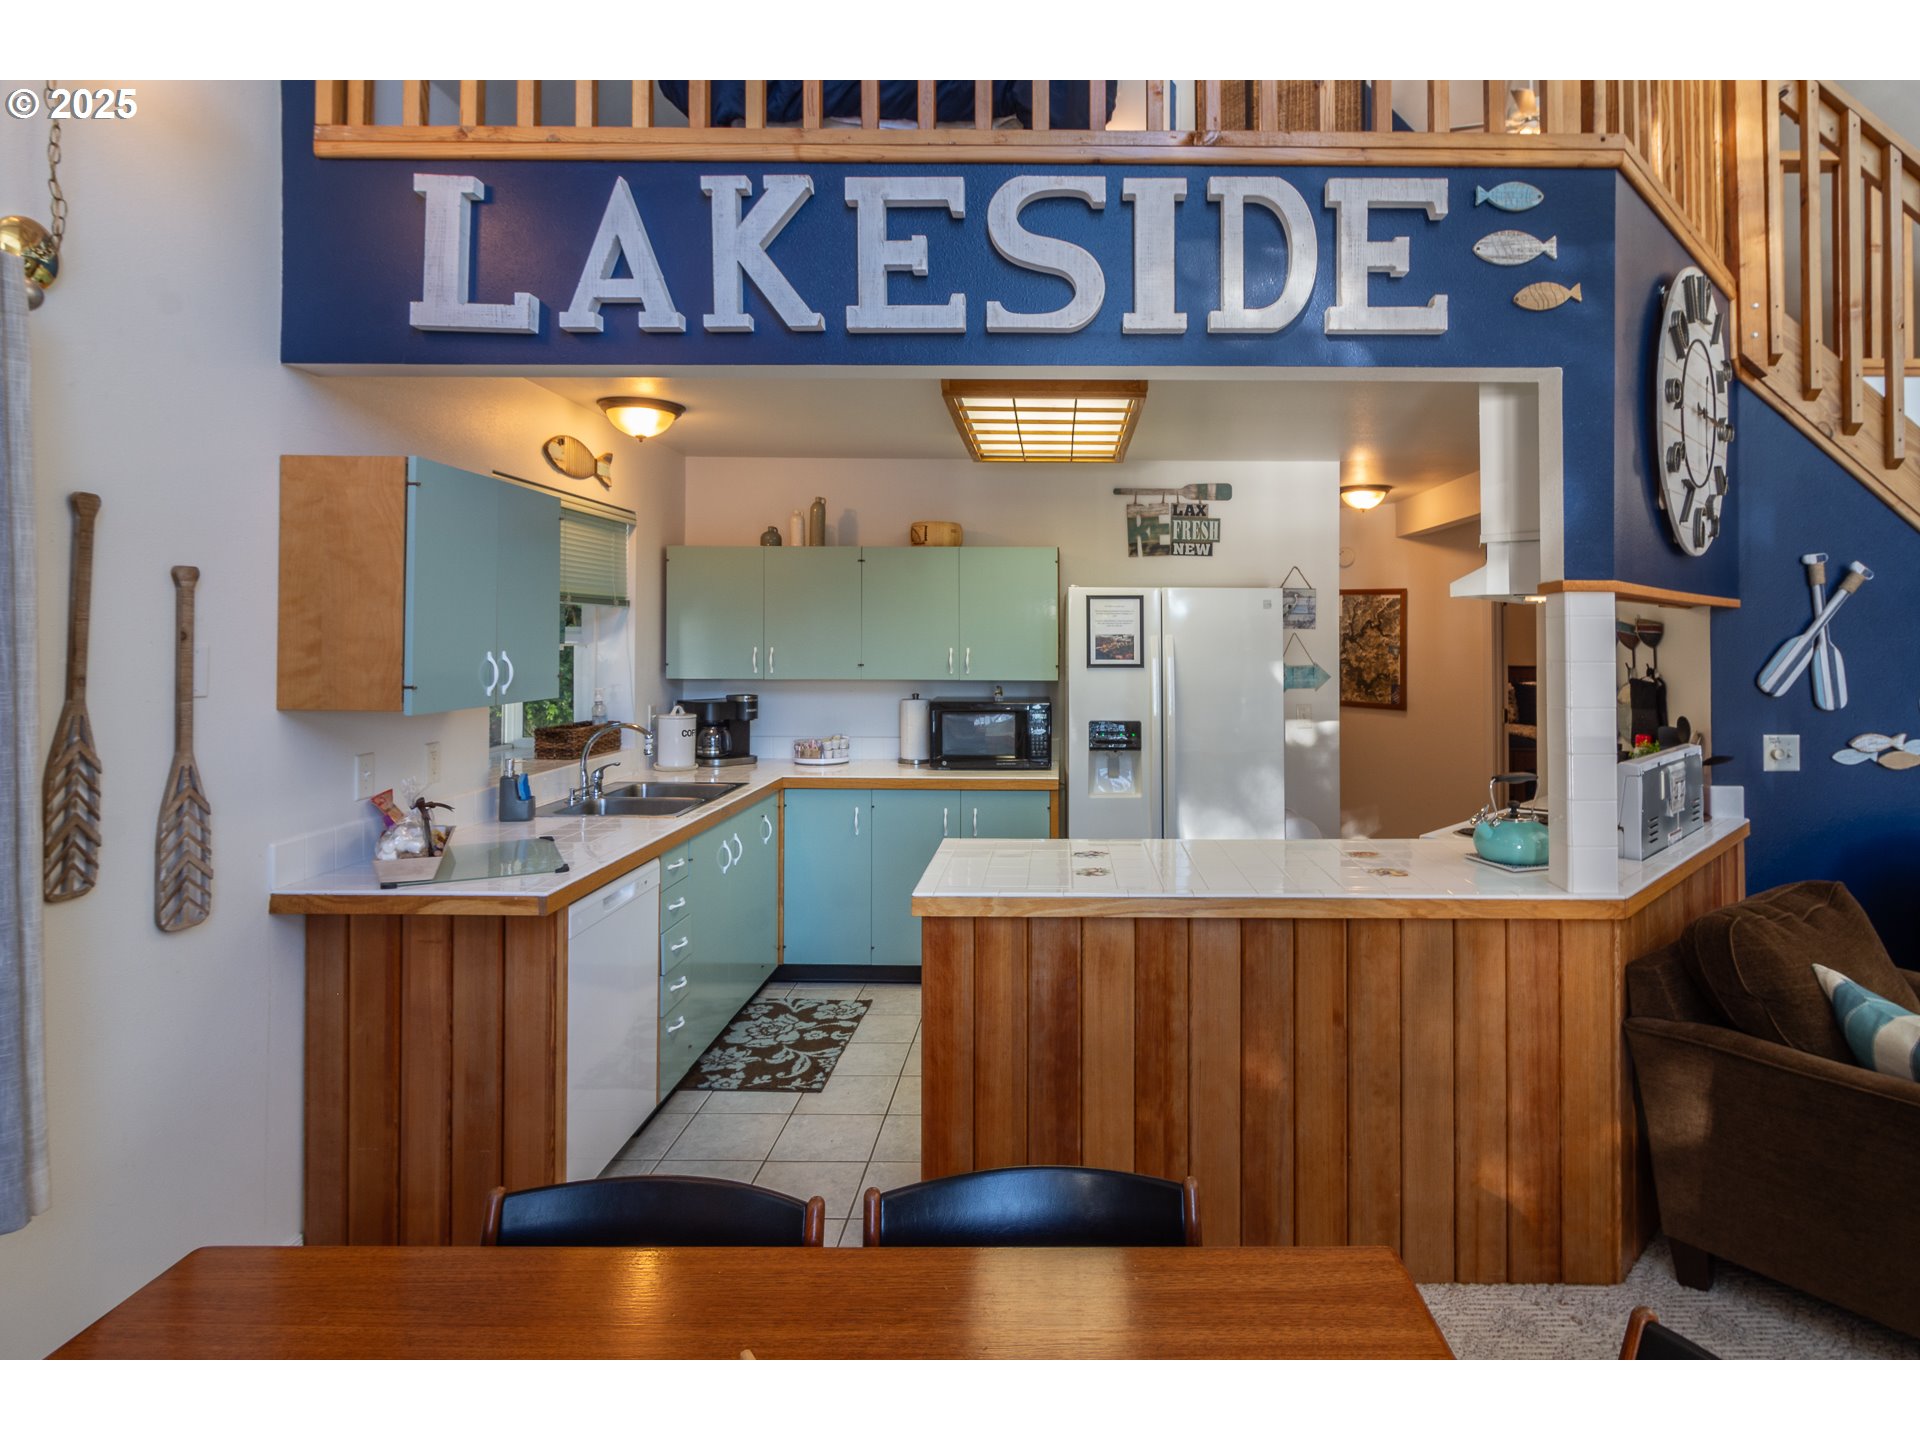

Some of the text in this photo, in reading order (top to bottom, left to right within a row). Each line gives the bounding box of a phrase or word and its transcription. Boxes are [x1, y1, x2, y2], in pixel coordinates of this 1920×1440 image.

[409, 173, 1448, 335] LAKESIDE
[1173, 504, 1207, 517] LAX
[1126, 503, 1171, 557] RE
[1172, 519, 1220, 541] FRESH
[1172, 542, 1211, 556] NEW
